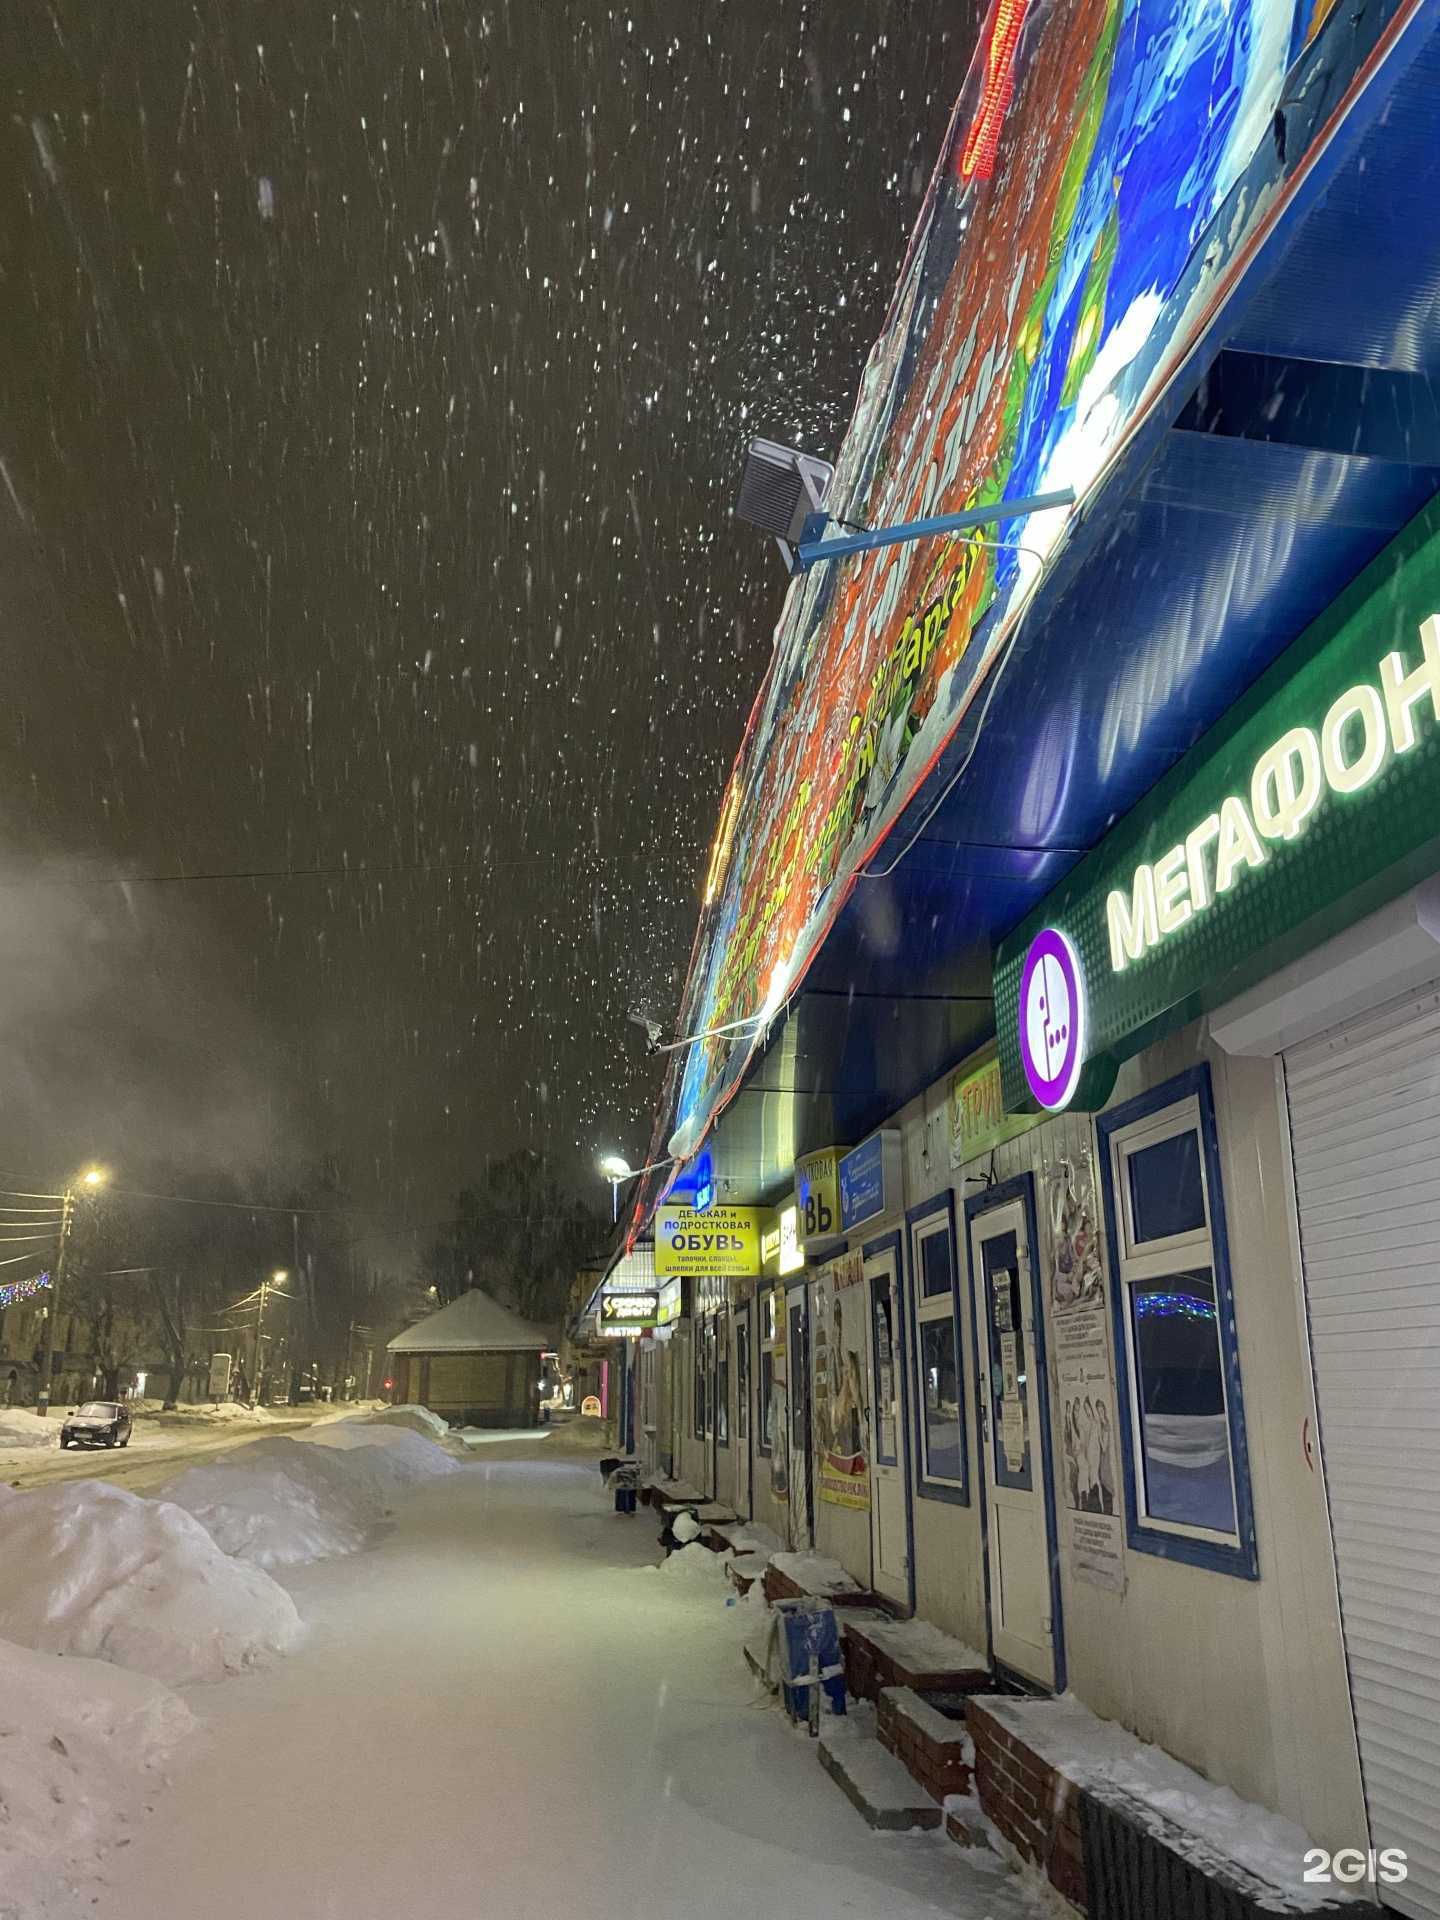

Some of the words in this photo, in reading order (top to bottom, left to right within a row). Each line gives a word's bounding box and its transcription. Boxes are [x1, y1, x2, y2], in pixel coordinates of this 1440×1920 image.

[1106, 613, 1440, 972] МЕГАФОН
[678, 1210, 727, 1219] ДЕТСКАЯ
[664, 1221, 751, 1231] ПОДРОСТКОВАЯ
[671, 1234, 744, 1251] ОБУВЬ
